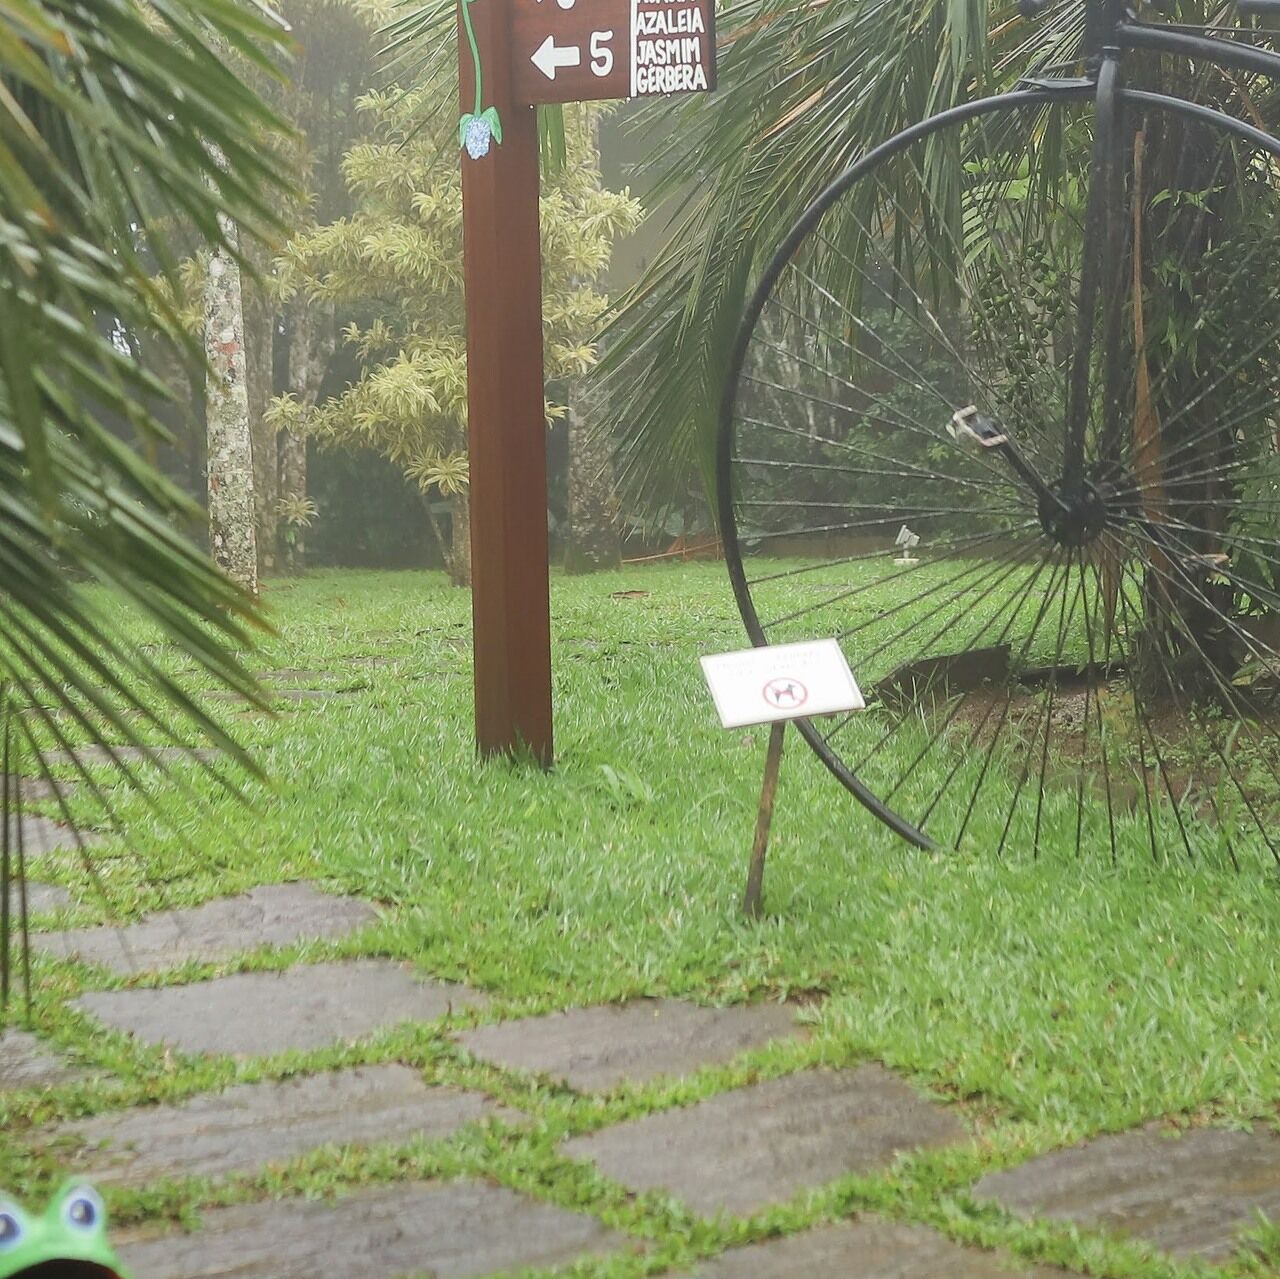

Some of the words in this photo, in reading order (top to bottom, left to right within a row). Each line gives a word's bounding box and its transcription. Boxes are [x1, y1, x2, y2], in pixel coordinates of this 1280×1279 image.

[636, 7, 705, 36] AZALEIA
[589, 29, 614, 77] 5
[636, 36, 700, 65] JASMIM
[637, 63, 708, 94] GÉRBERA
